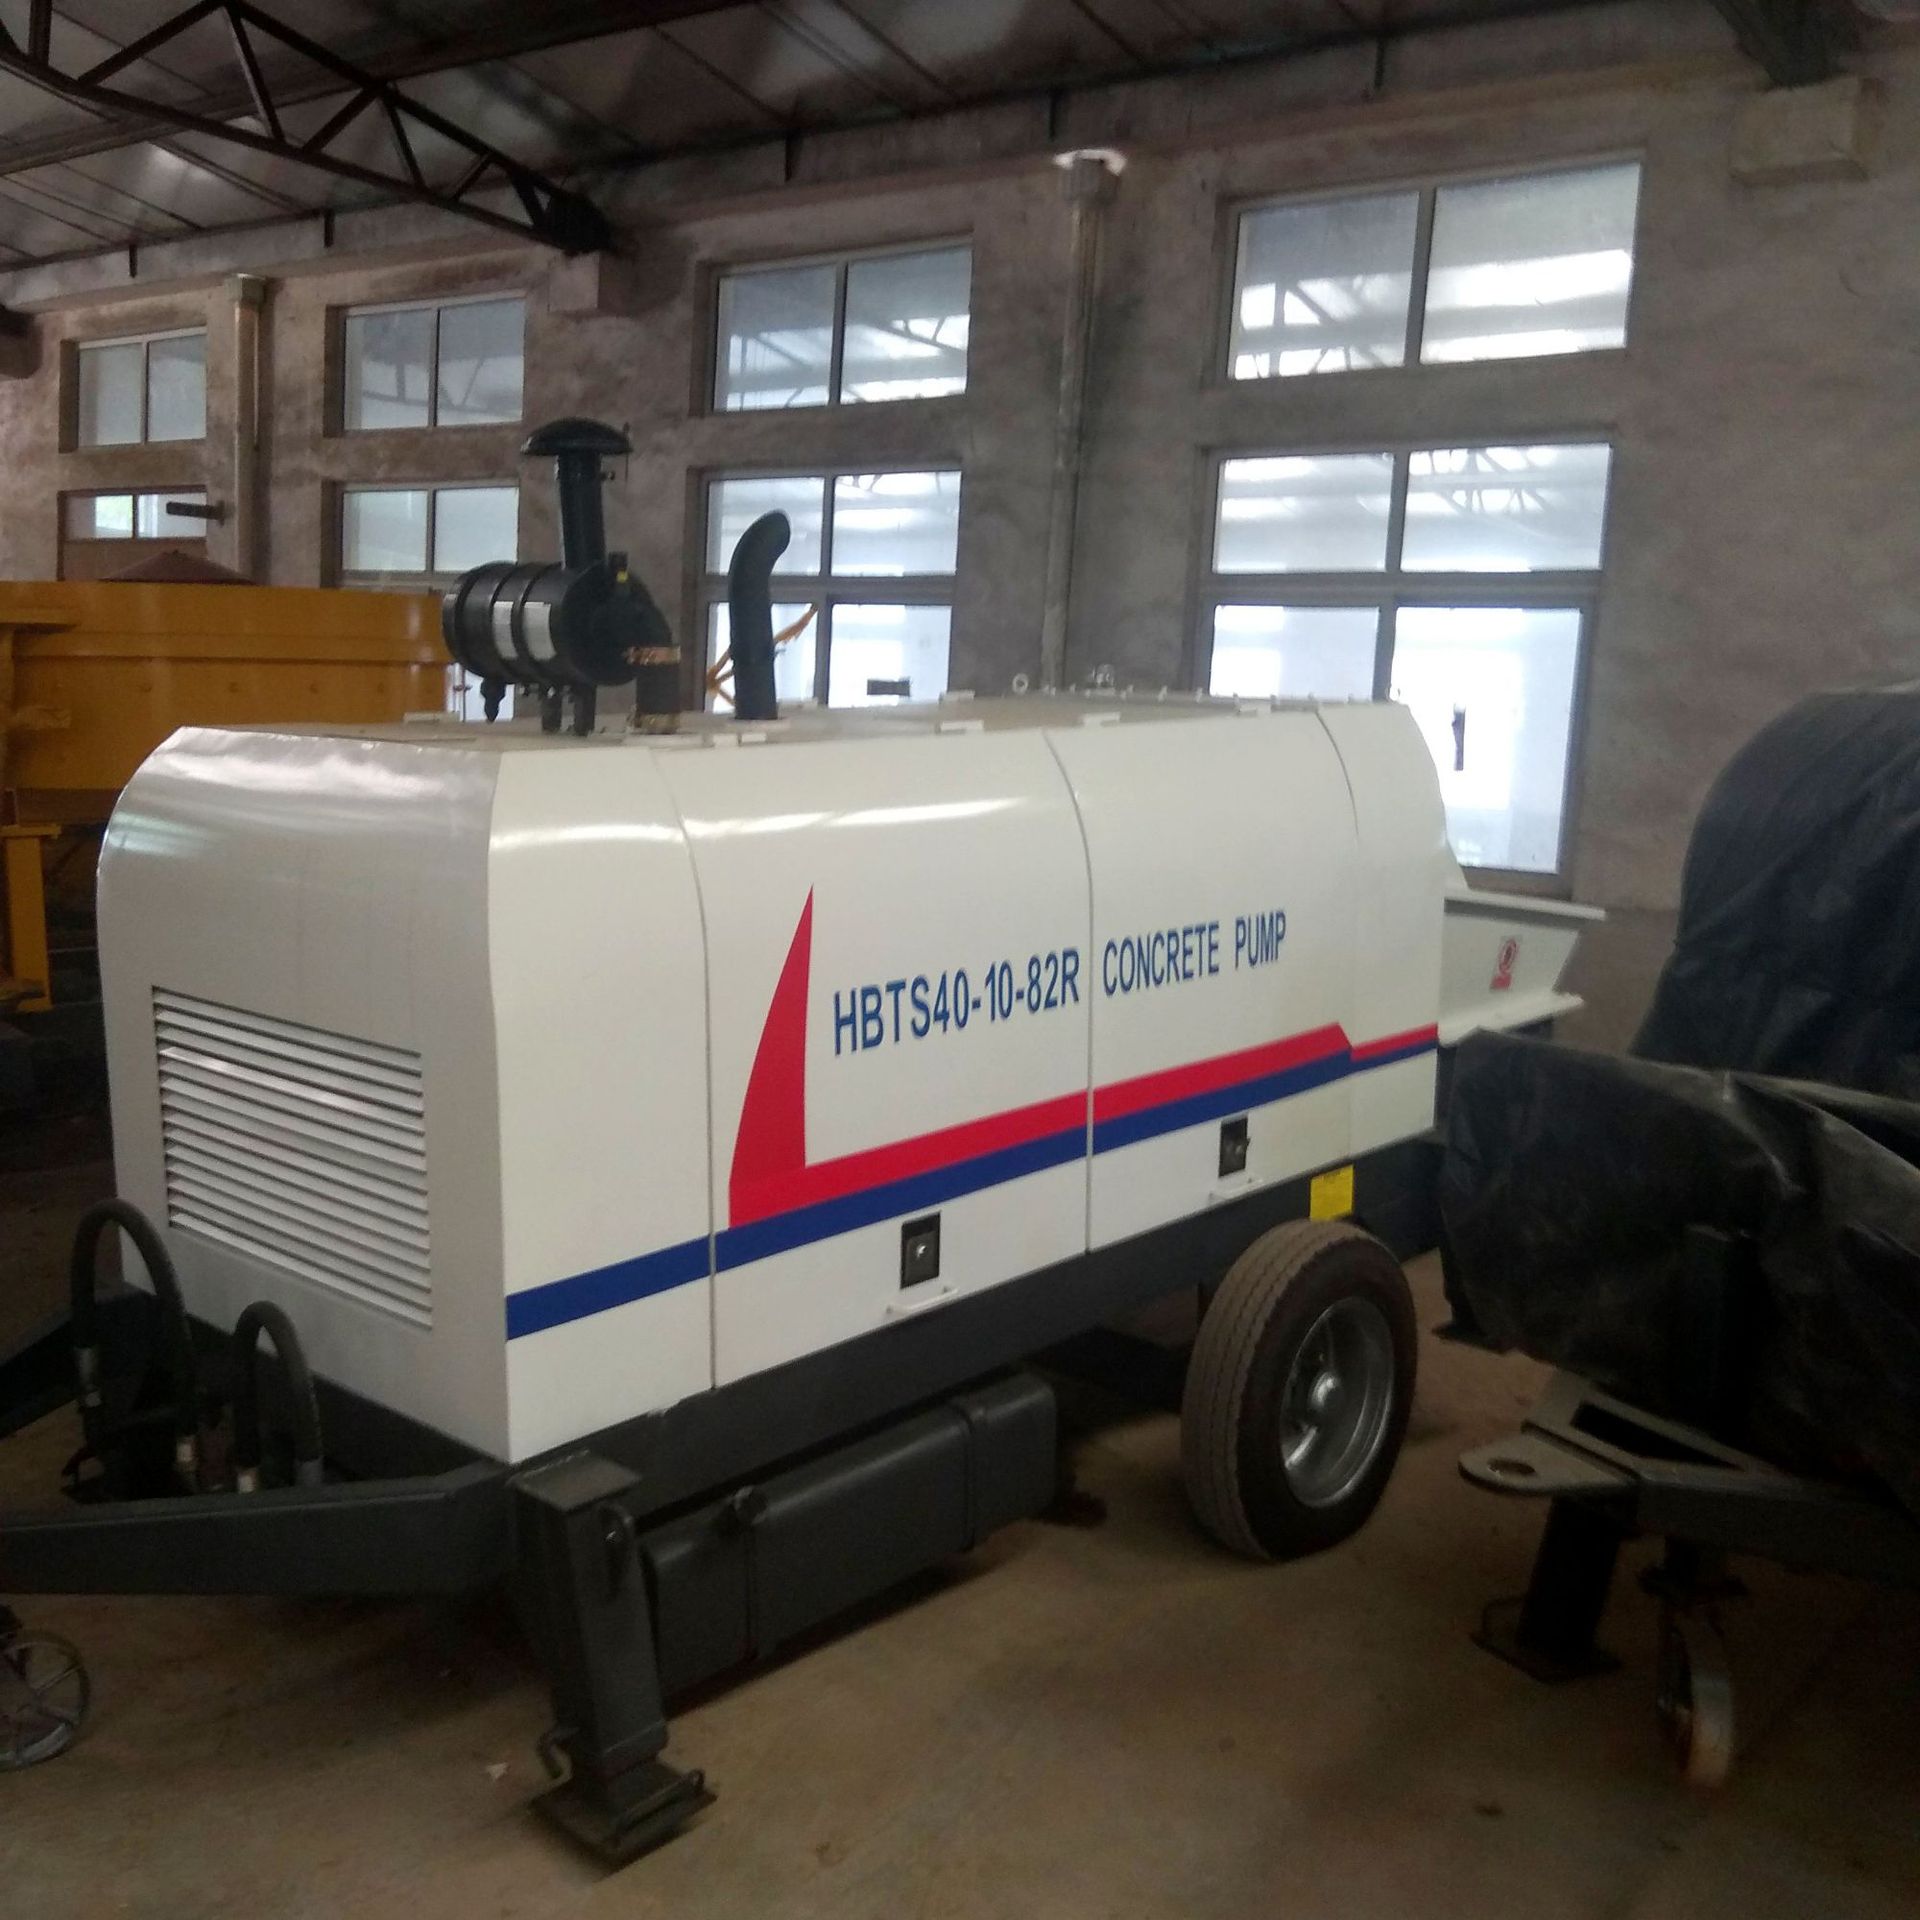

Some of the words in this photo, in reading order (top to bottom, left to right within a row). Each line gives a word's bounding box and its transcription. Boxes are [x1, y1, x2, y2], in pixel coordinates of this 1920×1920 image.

[834, 947, 1080, 1055] HBTS40-10-82R
[1103, 919, 1220, 997] CONCRETE
[1234, 910, 1287, 970] PUMP
